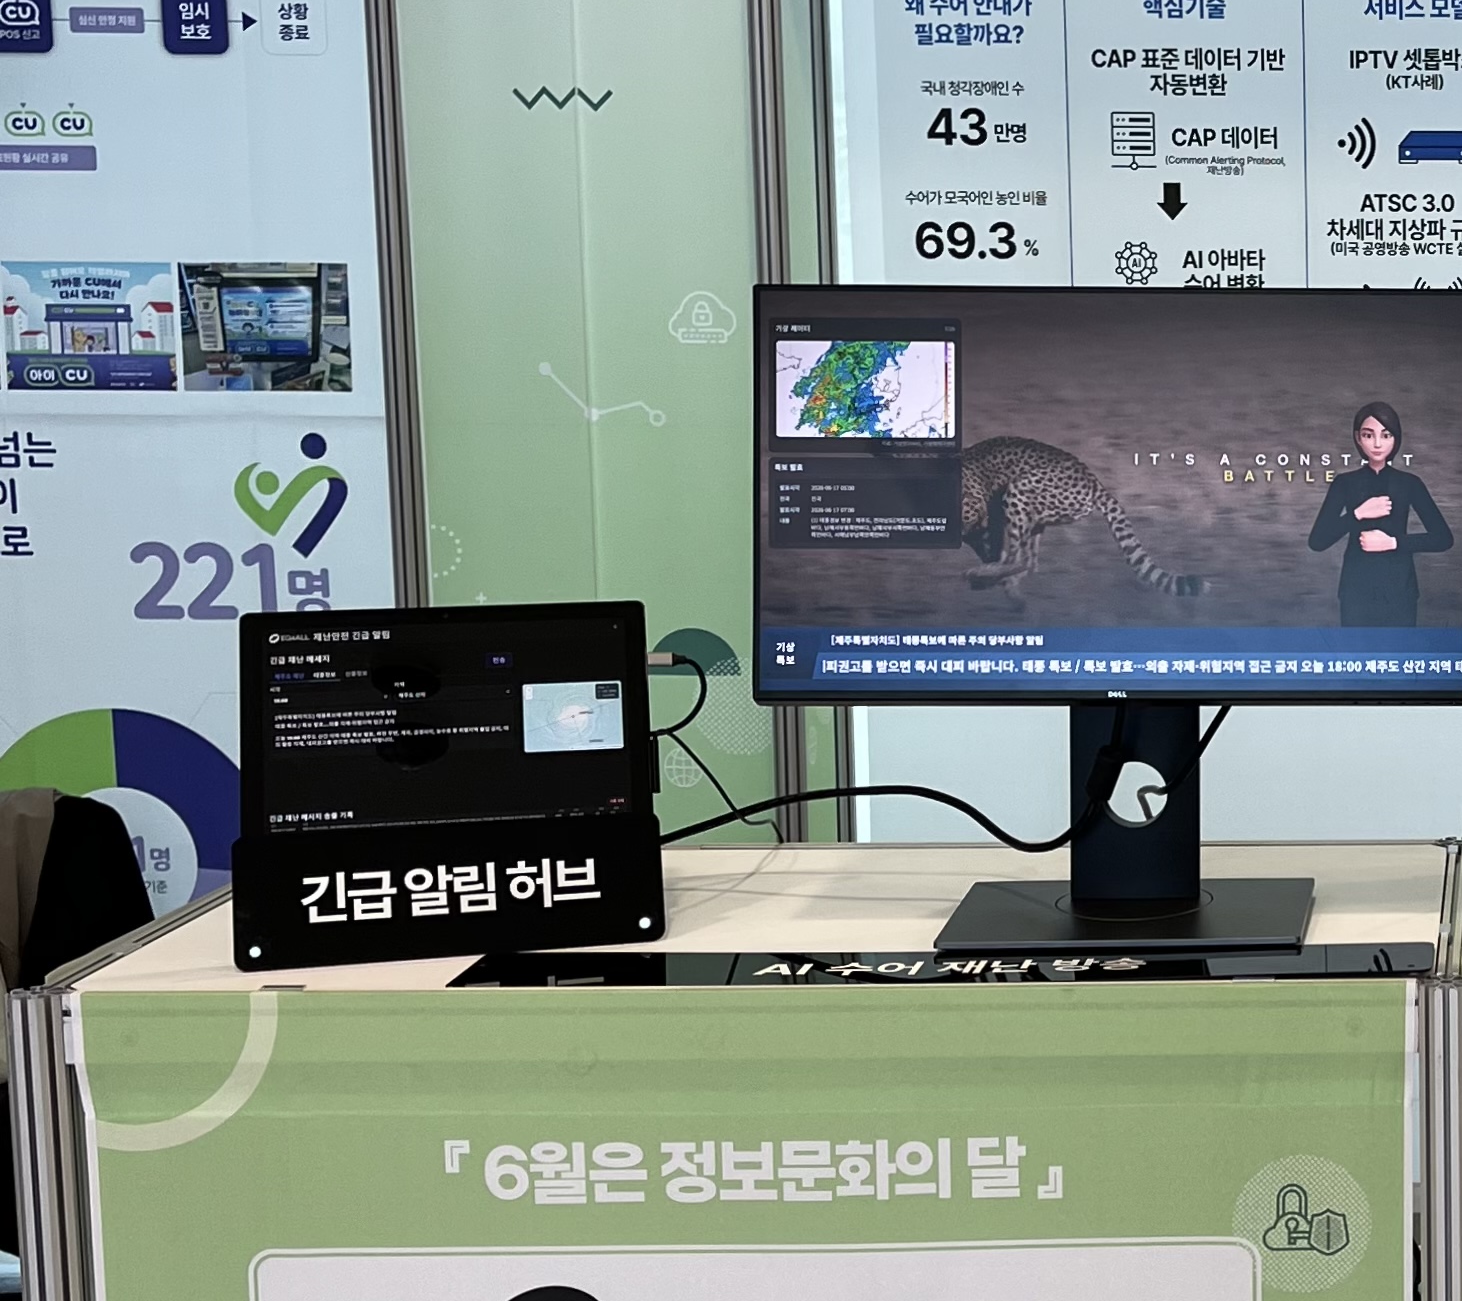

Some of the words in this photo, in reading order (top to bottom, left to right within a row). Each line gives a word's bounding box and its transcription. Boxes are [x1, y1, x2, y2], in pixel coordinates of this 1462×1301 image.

[179, 2, 209, 20] 임시
[278, 3, 308, 20] 상황
[181, 24, 211, 39] 보호
[279, 25, 310, 41] 종료
[915, 23, 1024, 46] 필요할까요?
[1091, 48, 1136, 68] CAP
[1141, 48, 1180, 70] 표준
[1184, 48, 1241, 71] 데이터
[1246, 48, 1286, 71] 기반
[1349, 50, 1398, 70] IPTV
[921, 81, 945, 95] 국내
[949, 81, 1009, 96] 청각장애인
[1012, 81, 1024, 96] 수
[1386, 74, 1443, 90] (KT사례)
[12, 118, 36, 131] CU
[60, 117, 85, 131] CU
[927, 108, 987, 146] 43
[994, 123, 1026, 143] 만명
[1165, 156, 1207, 166] (Common
[1210, 156, 1245, 167] Alerting
[1247, 156, 1286, 167] Protocol,
[905, 190, 942, 206] 수어가
[945, 190, 993, 206] 모국어인
[995, 191, 1020, 206] 농인
[1023, 191, 1048, 206] 비율
[1360, 194, 1417, 212] ATSC
[1423, 194, 1454, 212] 3.0
[916, 222, 1017, 259] 69.3
[1024, 239, 1039, 256] %
[29, 370, 55, 381] 아이
[65, 370, 88, 381] CU
[1135, 452, 1194, 465] IT'S
[1220, 454, 1231, 466] A
[1255, 454, 1414, 466] CONSTT
[1224, 470, 1335, 482] BATTLE
[776, 642, 795, 653] 기상
[1248, 660, 1271, 673] 접근
[1275, 660, 1297, 673] 금지
[1301, 660, 1324, 673] 오늘
[1327, 660, 1362, 673] 18:00
[1365, 660, 1399, 673] 제주도
[1403, 660, 1425, 674] 산간
[1429, 660, 1451, 674] 지역
[301, 870, 397, 923] 긴급
[404, 862, 497, 917] 알림
[506, 858, 601, 908] 허브
[753, 963, 816, 976] AI
[829, 959, 921, 976] 수어
[938, 959, 1037, 974] 재난
[1054, 957, 1147, 973] 방송
[485, 1142, 647, 1204] 6월은
[661, 1138, 951, 1203] 정보문화의
[967, 1136, 1026, 1198] 달
